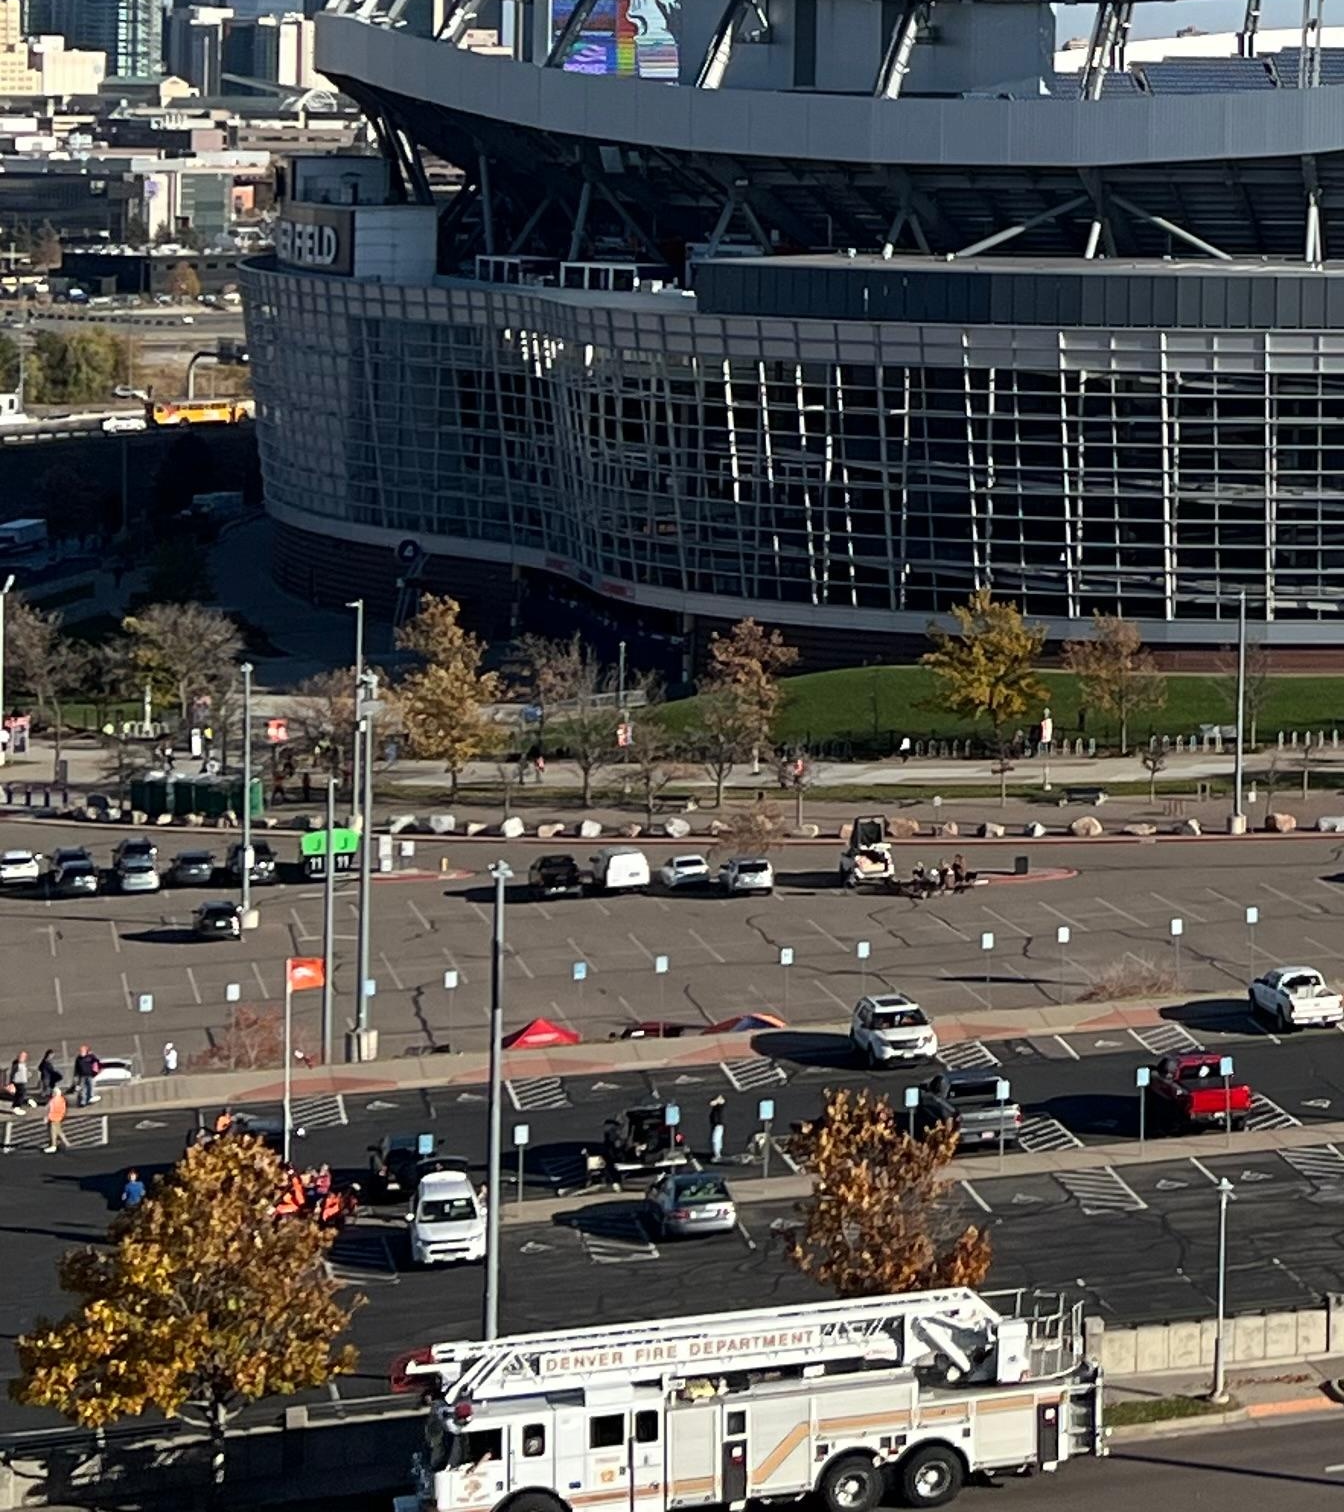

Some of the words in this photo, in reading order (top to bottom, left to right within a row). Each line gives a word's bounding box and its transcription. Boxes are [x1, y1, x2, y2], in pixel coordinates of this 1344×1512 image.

[312, 838, 322, 851] J
[340, 837, 349, 849] J
[310, 856, 322, 870] 11
[336, 855, 350, 868] 11
[546, 1351, 624, 1372] DENVER
[635, 1345, 678, 1362] FIRE
[689, 1330, 814, 1356] DEPARTMENT
